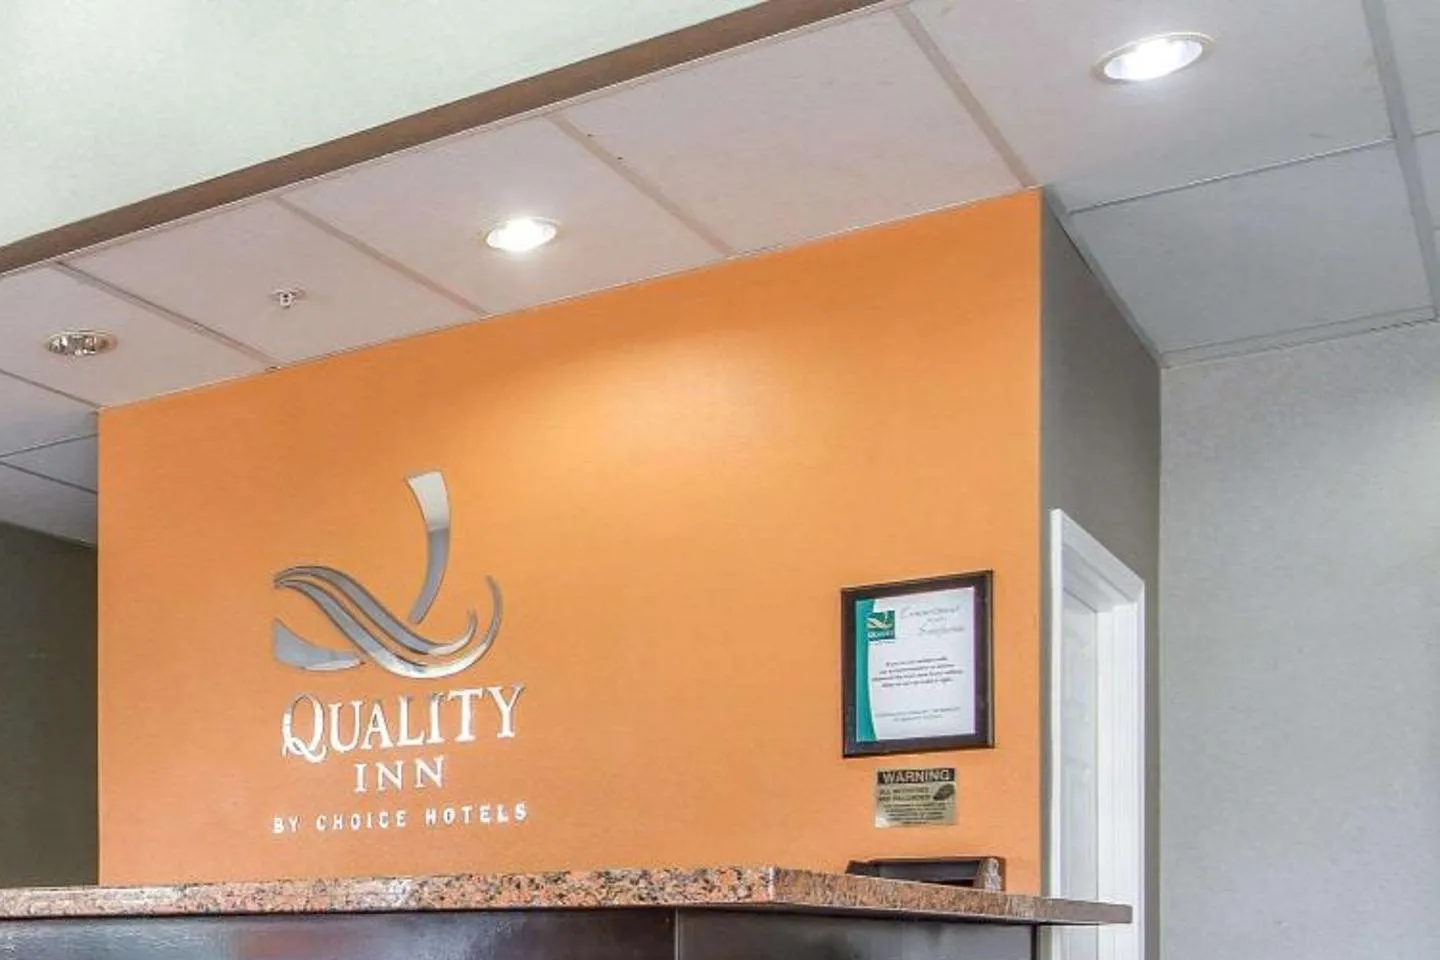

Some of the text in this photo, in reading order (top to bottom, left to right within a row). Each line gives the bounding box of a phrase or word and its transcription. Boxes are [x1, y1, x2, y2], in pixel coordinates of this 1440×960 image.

[281, 684, 525, 763] QUALITY
[353, 754, 445, 793] INN
[882, 769, 950, 784] WARNING
[272, 802, 529, 834] BY CHOICE HOTELS
